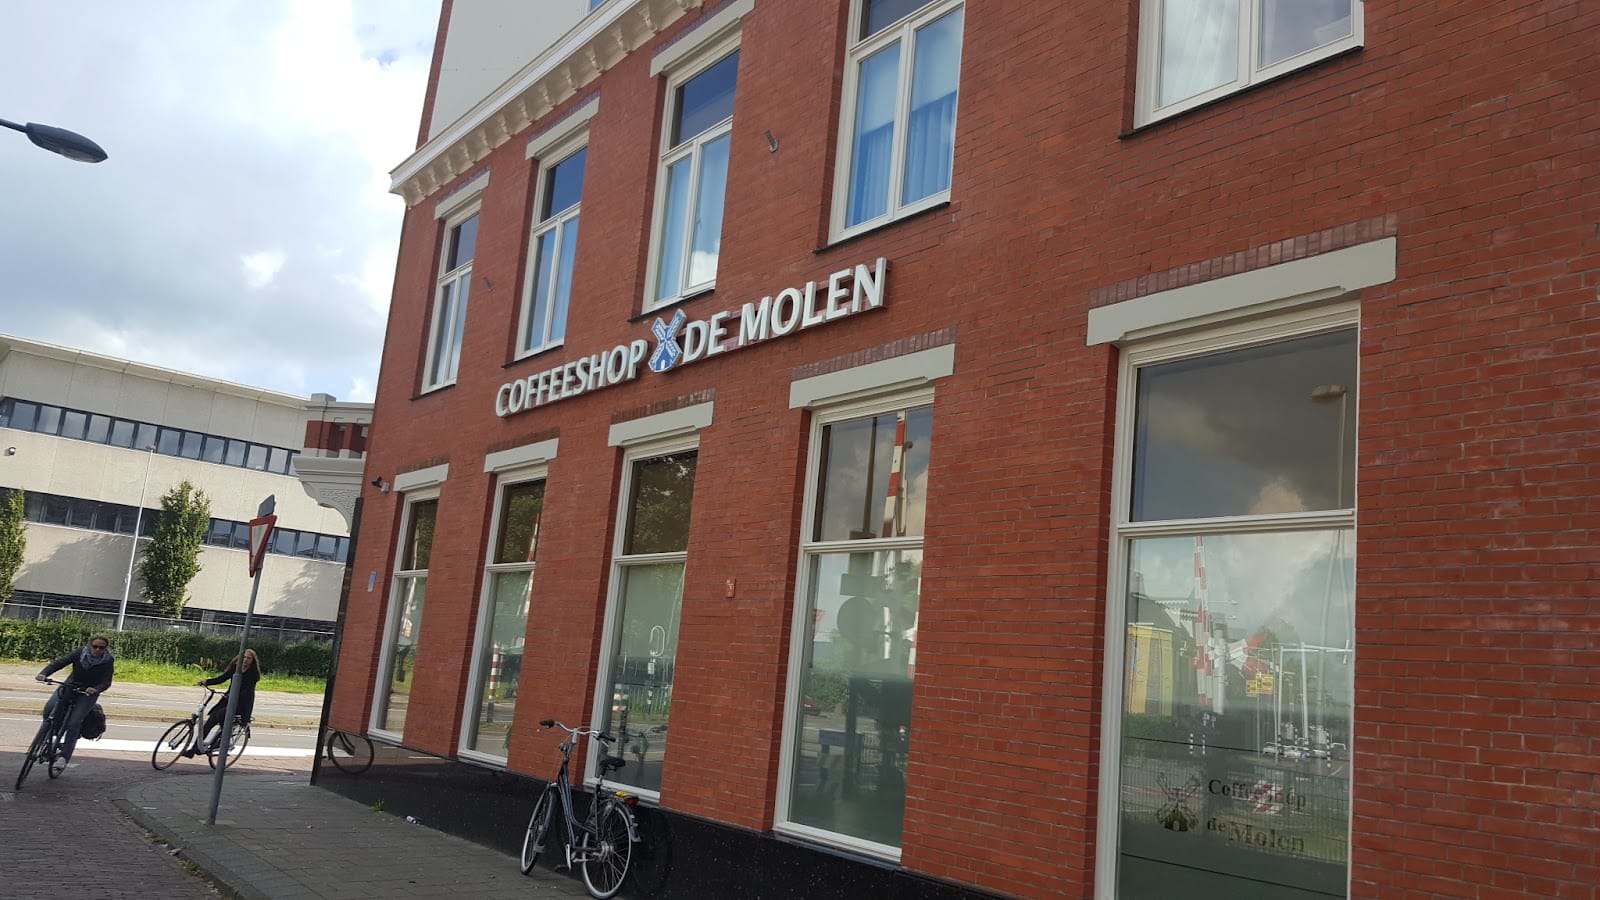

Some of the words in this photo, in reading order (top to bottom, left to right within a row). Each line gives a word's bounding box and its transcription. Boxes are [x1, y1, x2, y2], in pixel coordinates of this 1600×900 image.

[495, 339, 649, 417] COFFEESHOP
[683, 310, 732, 362] DE
[738, 256, 887, 346] MOLEN
